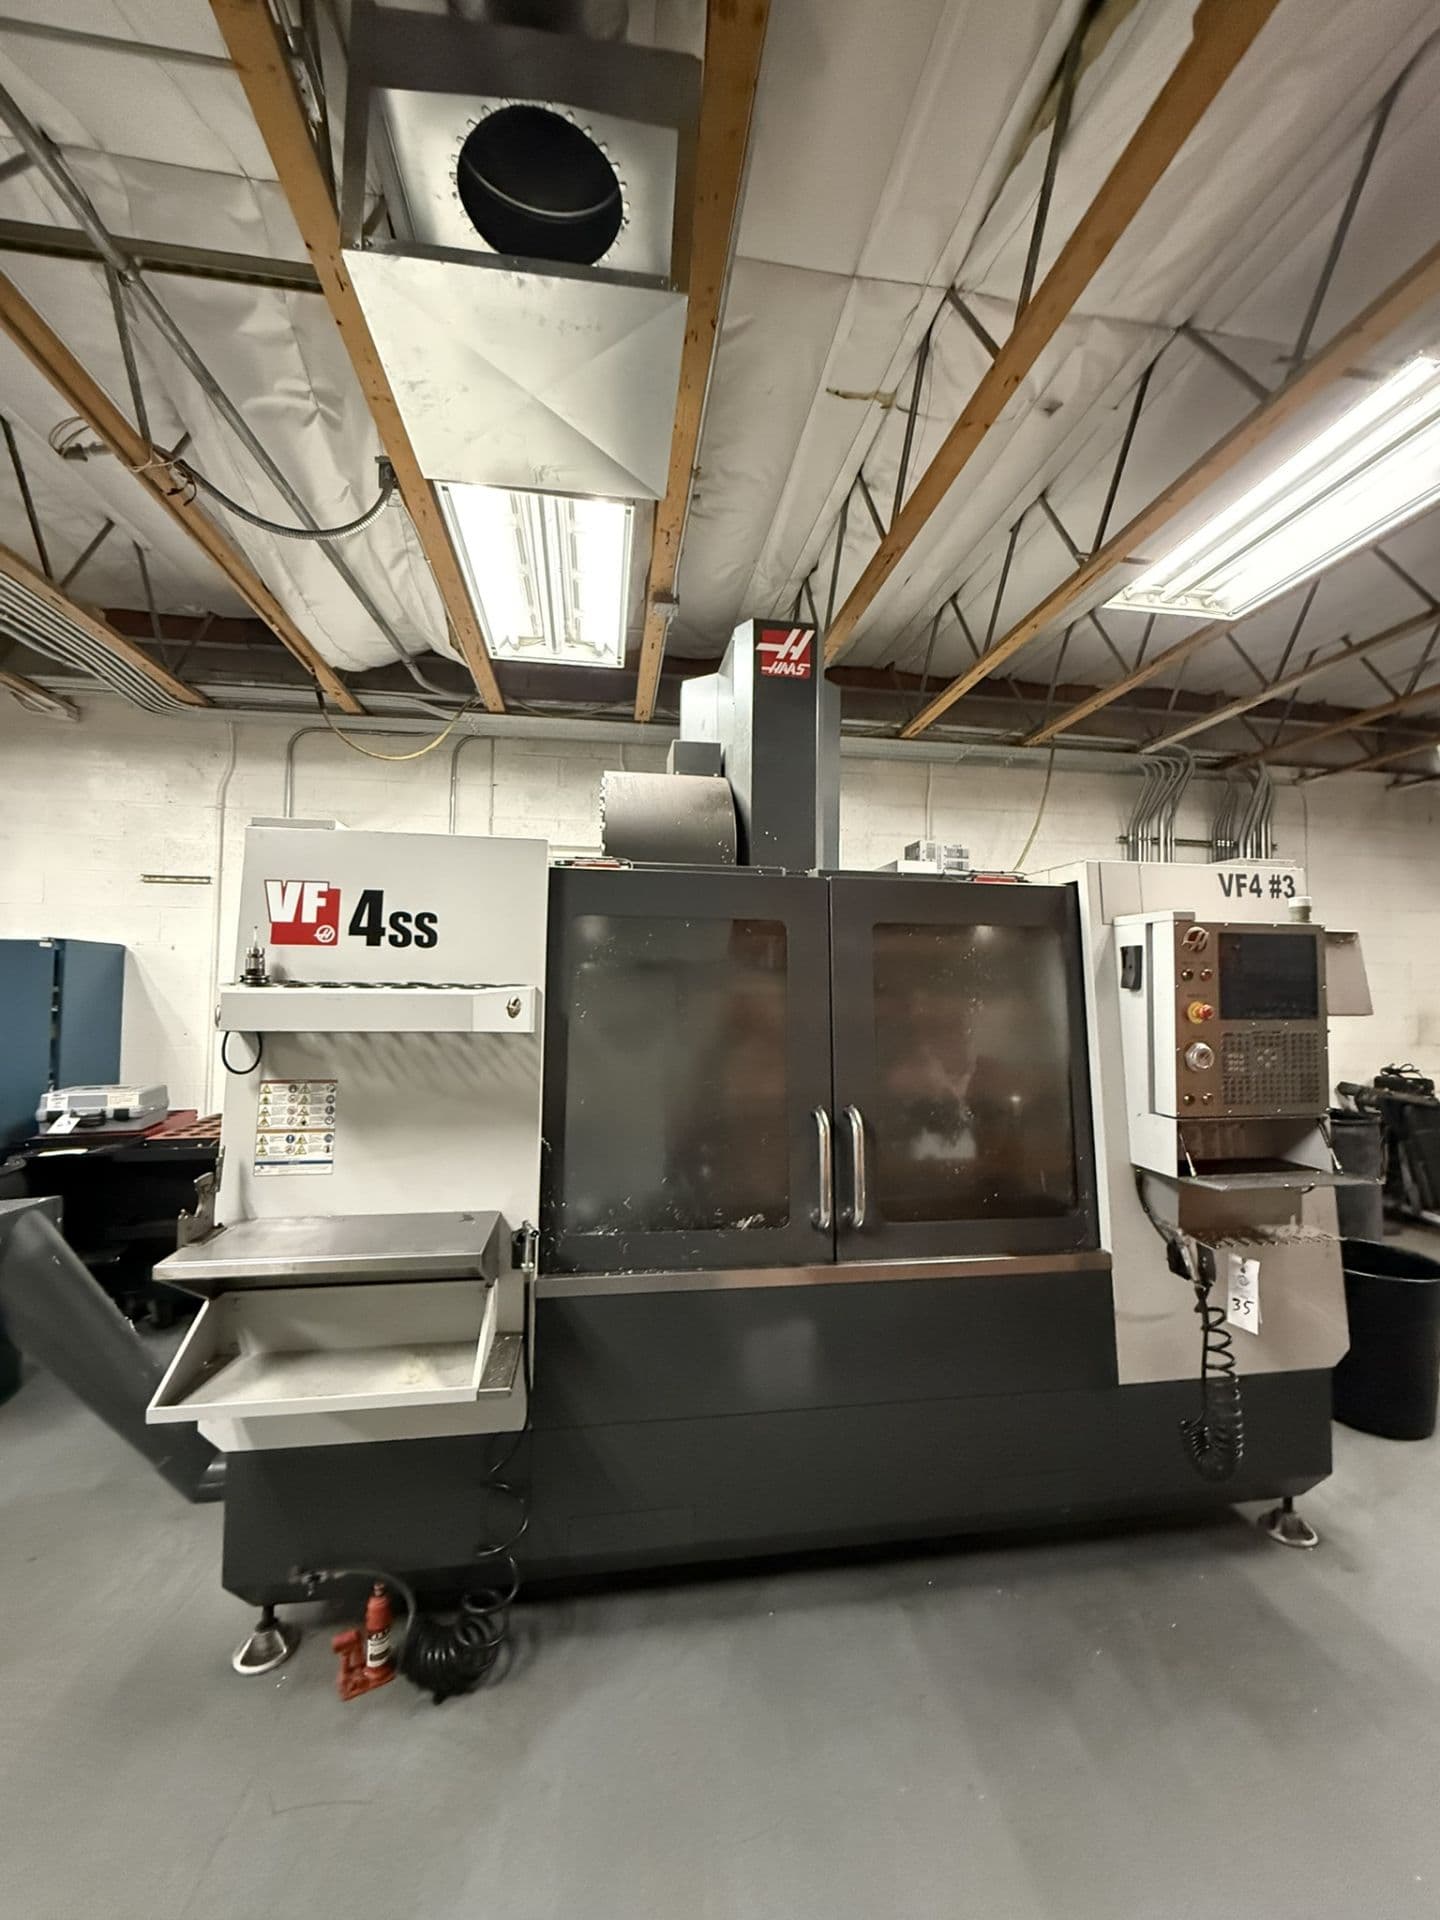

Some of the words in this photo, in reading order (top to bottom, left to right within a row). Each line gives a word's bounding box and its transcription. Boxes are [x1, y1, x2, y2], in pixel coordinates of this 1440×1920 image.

[760, 660, 811, 676] HAAS
[1217, 873, 1263, 898] VF4
[1268, 874, 1296, 899] #3
[264, 879, 330, 924] VF
[1232, 1297, 1255, 1315] 35
